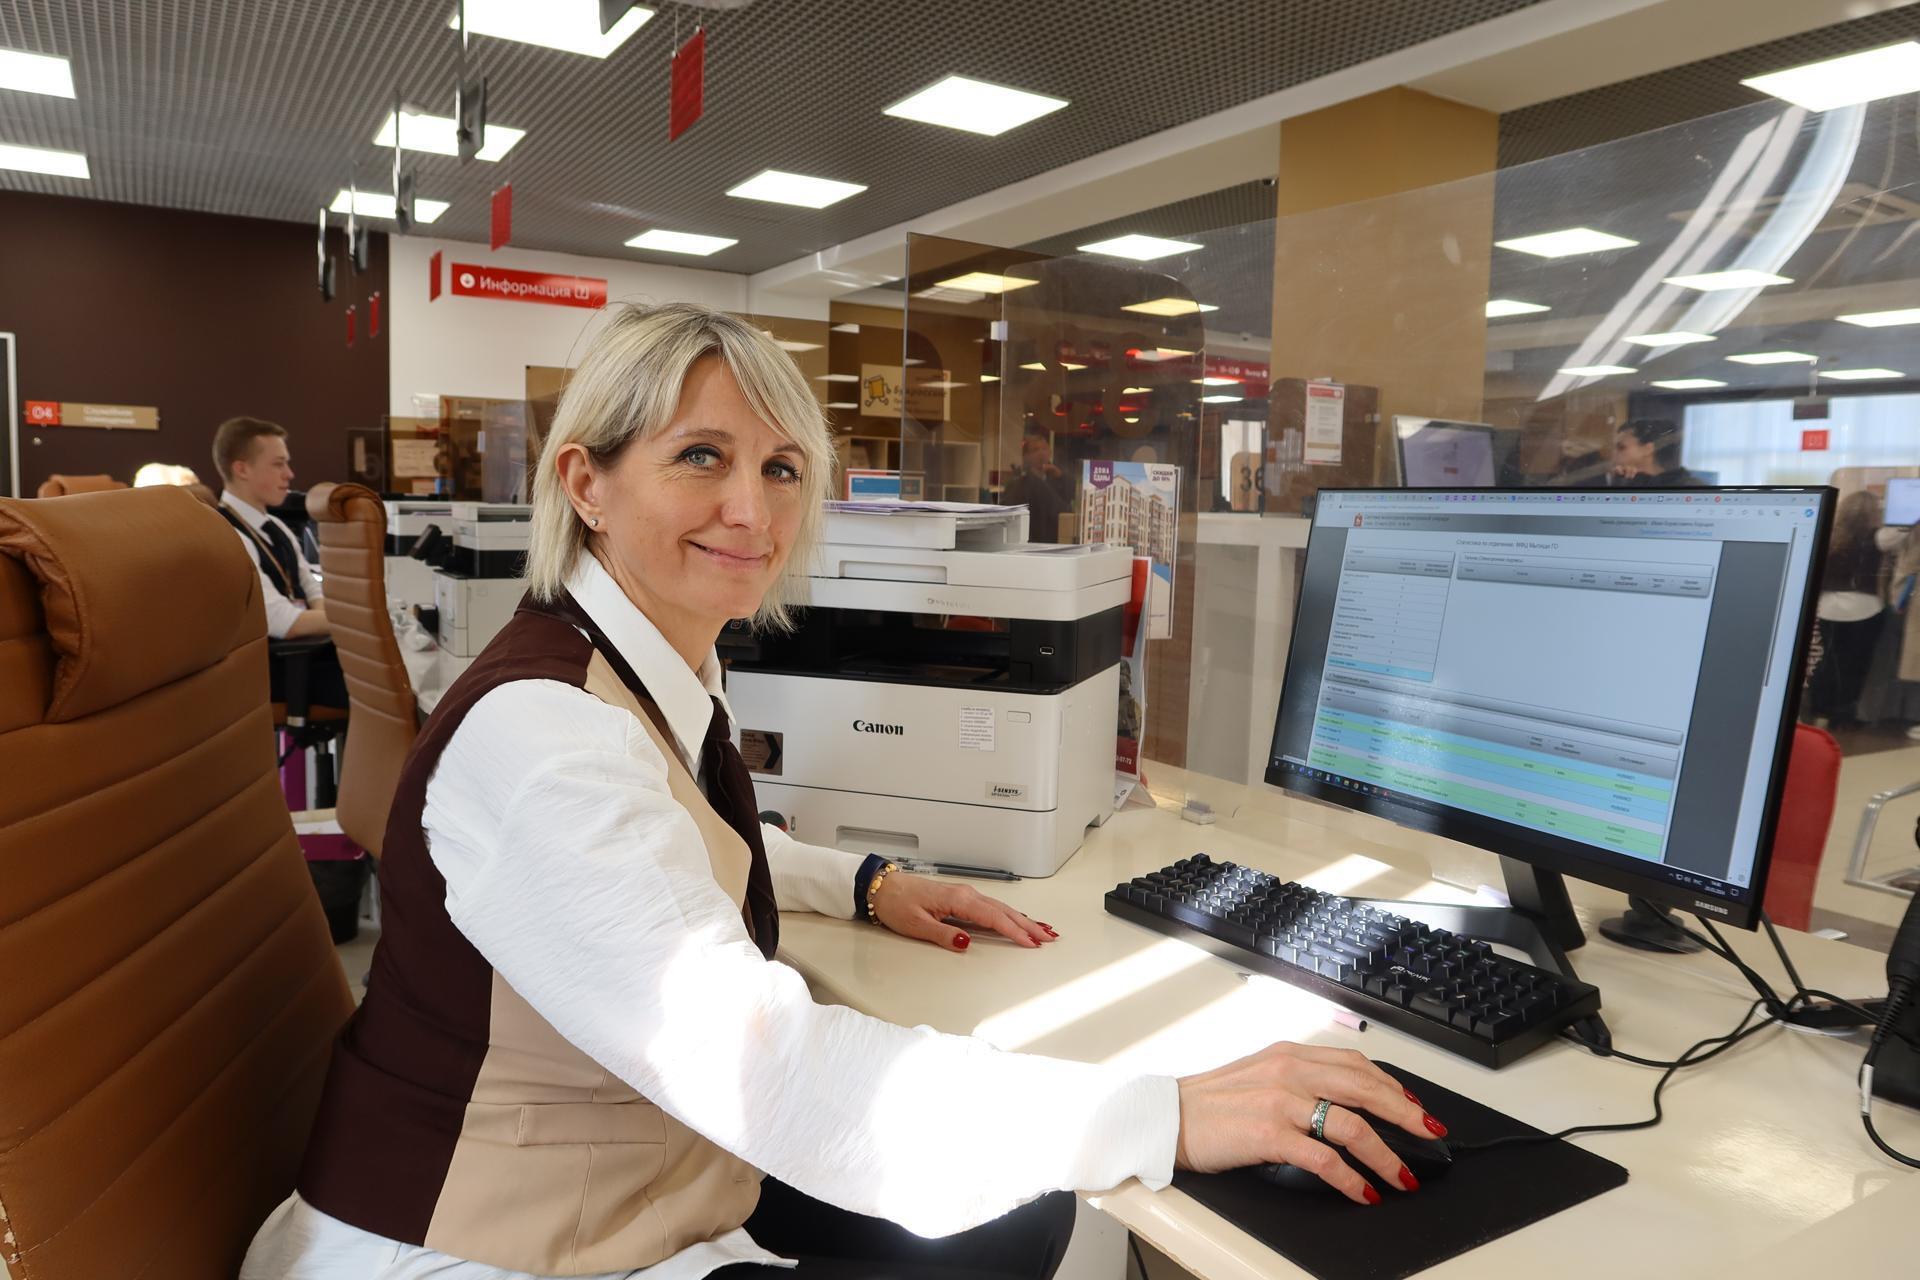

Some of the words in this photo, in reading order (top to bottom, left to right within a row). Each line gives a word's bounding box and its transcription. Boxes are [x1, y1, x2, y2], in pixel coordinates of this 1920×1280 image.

[480, 276, 571, 298] Информация
[32, 405, 53, 420] 04
[852, 719, 904, 736] Canon
[1694, 900, 1729, 915] SAMSUNG
